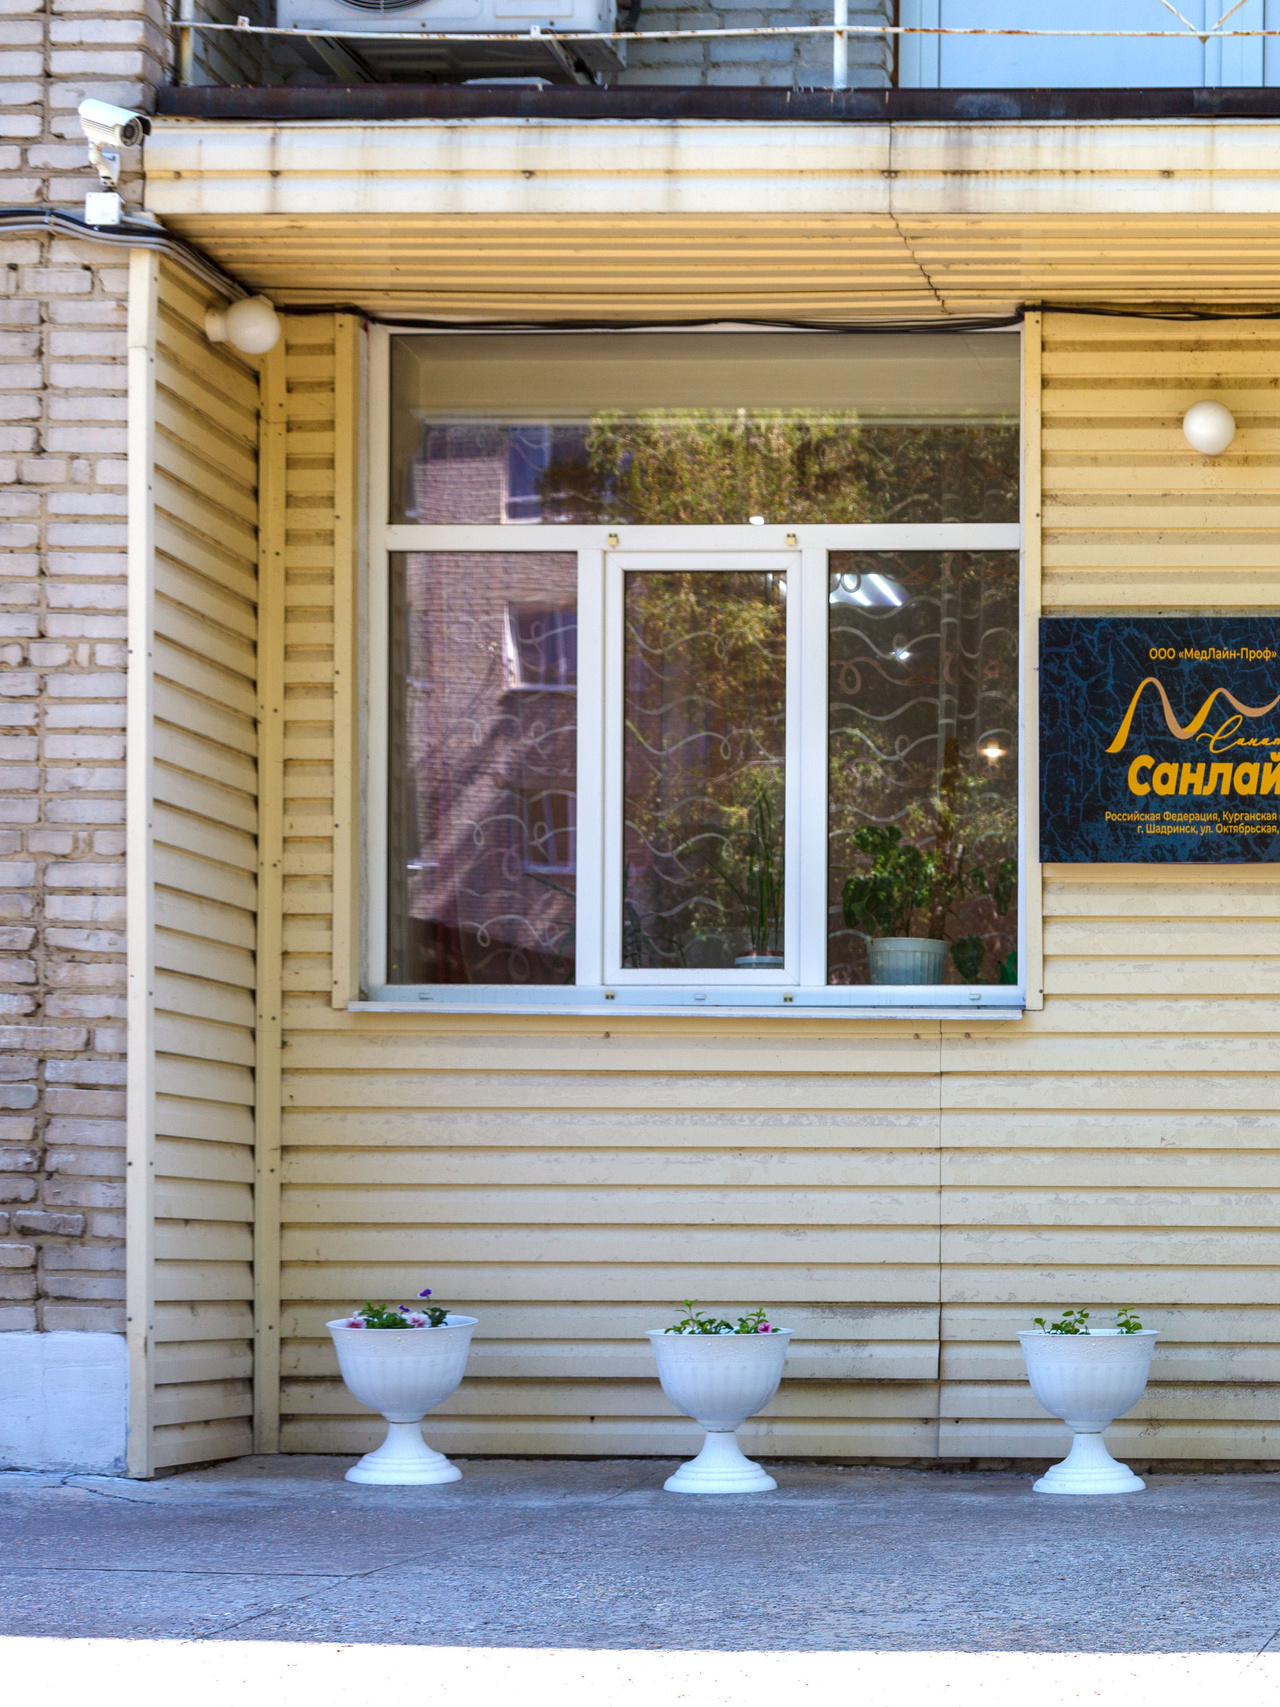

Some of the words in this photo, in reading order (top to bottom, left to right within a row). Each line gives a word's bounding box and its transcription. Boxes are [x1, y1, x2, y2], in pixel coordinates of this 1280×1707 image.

[1149, 647, 1176, 660] ООО
[1178, 647, 1277, 662] «МедЛайн-Проф»
[1105, 810, 1161, 823] Российская
[1163, 810, 1221, 824] Федерация,
[1222, 810, 1278, 824] Курганская
[1137, 824, 1144, 834] г.
[1146, 822, 1199, 836] Шадринск,
[1200, 822, 1214, 836] ул.
[1215, 822, 1280, 836] Октябрьская,
